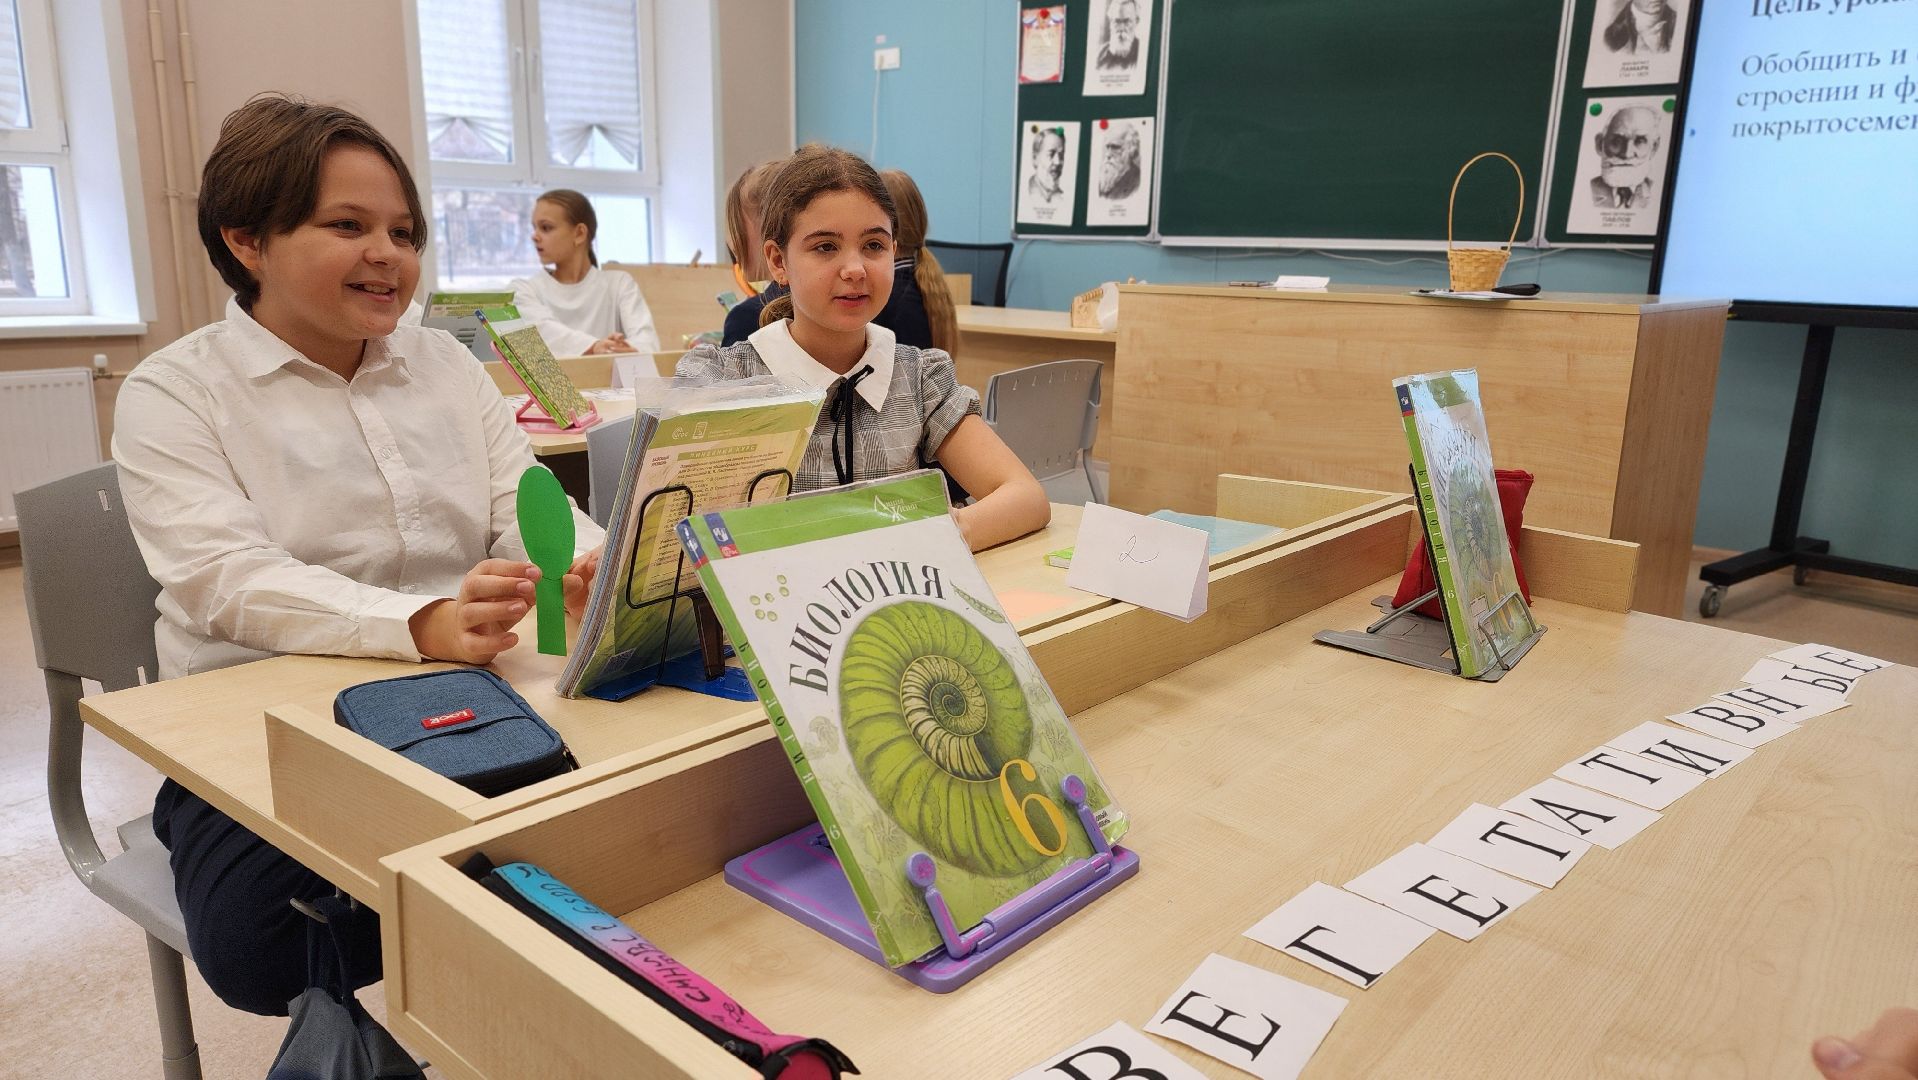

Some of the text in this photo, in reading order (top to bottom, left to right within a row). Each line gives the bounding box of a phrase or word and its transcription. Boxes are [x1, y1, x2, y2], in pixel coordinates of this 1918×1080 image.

[1742, 48, 1907, 76] Обобщить и
[1737, 84, 1859, 111] строении
[1869, 83, 1885, 99] и
[1119, 534, 1159, 563] 2
[788, 560, 946, 696] БИОЛОГИЯ
[738, 639, 814, 783] БИОЛОГИЯ
[1000, 759, 1068, 856] 6
[829, 824, 841, 840] 6
